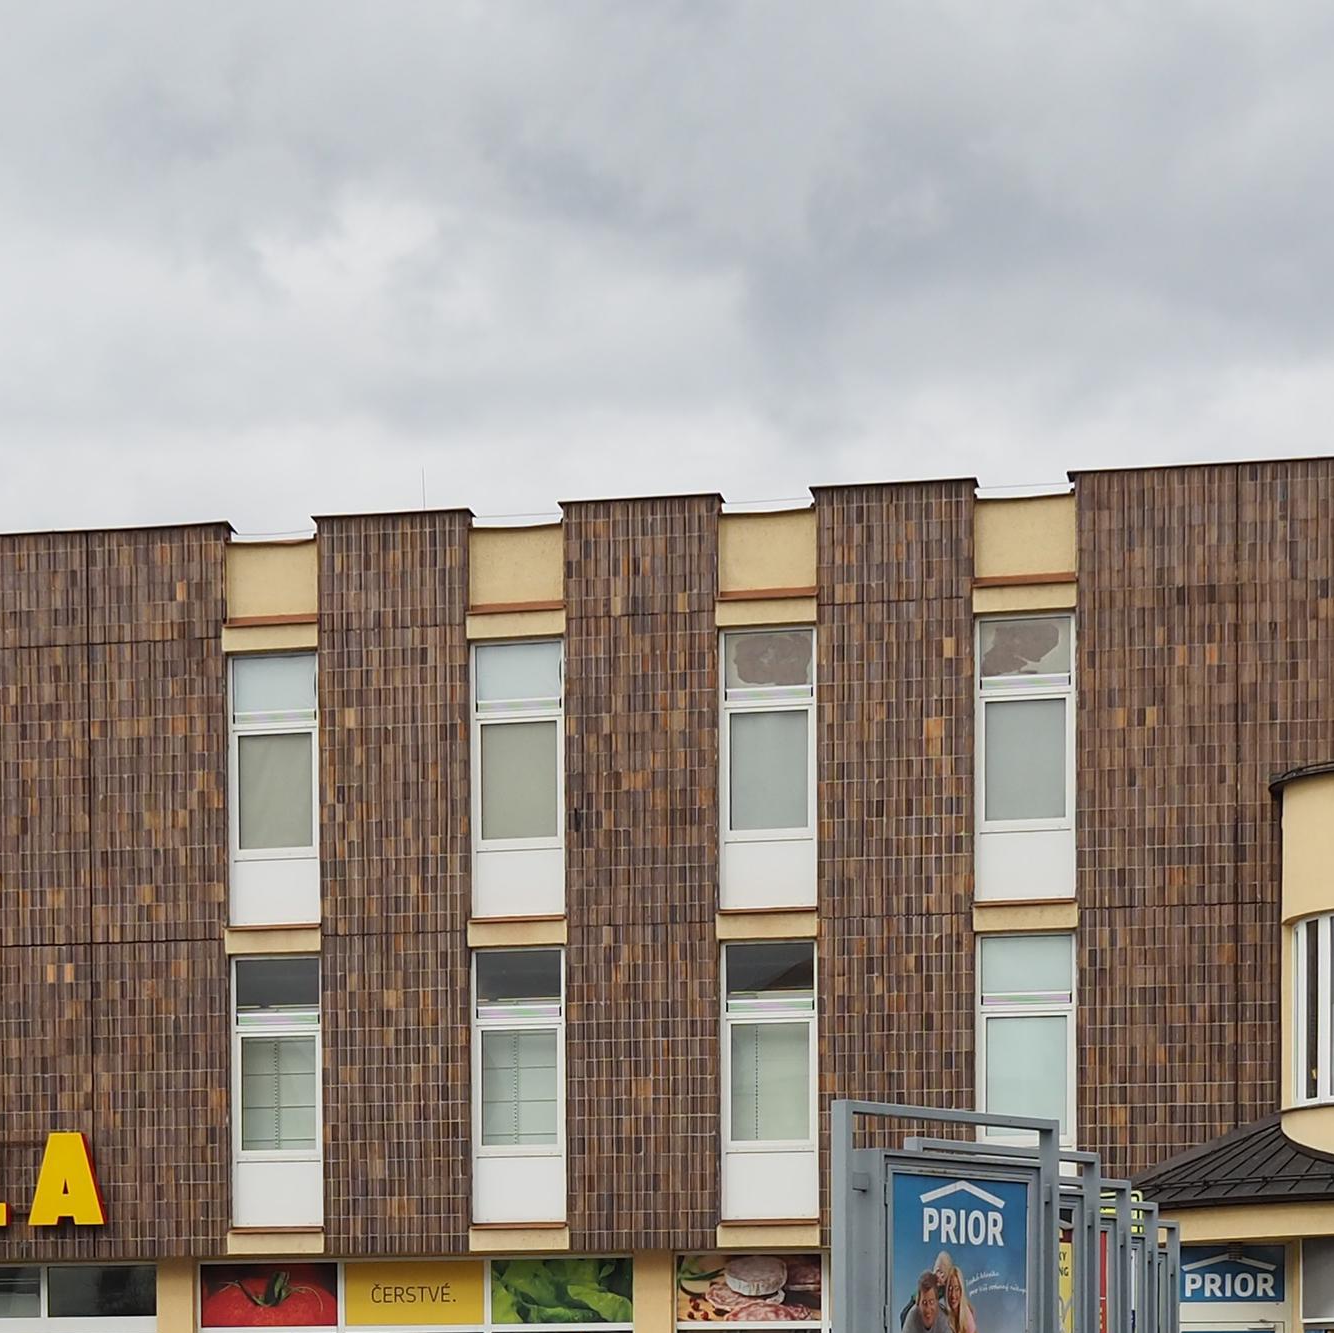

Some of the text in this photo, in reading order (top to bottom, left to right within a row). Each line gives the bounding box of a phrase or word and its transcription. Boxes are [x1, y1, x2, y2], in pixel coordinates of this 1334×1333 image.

[922, 1206, 1005, 1247] PRIOR
[371, 1283, 457, 1303] ČERSTVÉ.
[1184, 1272, 1276, 1297] PRIOR
